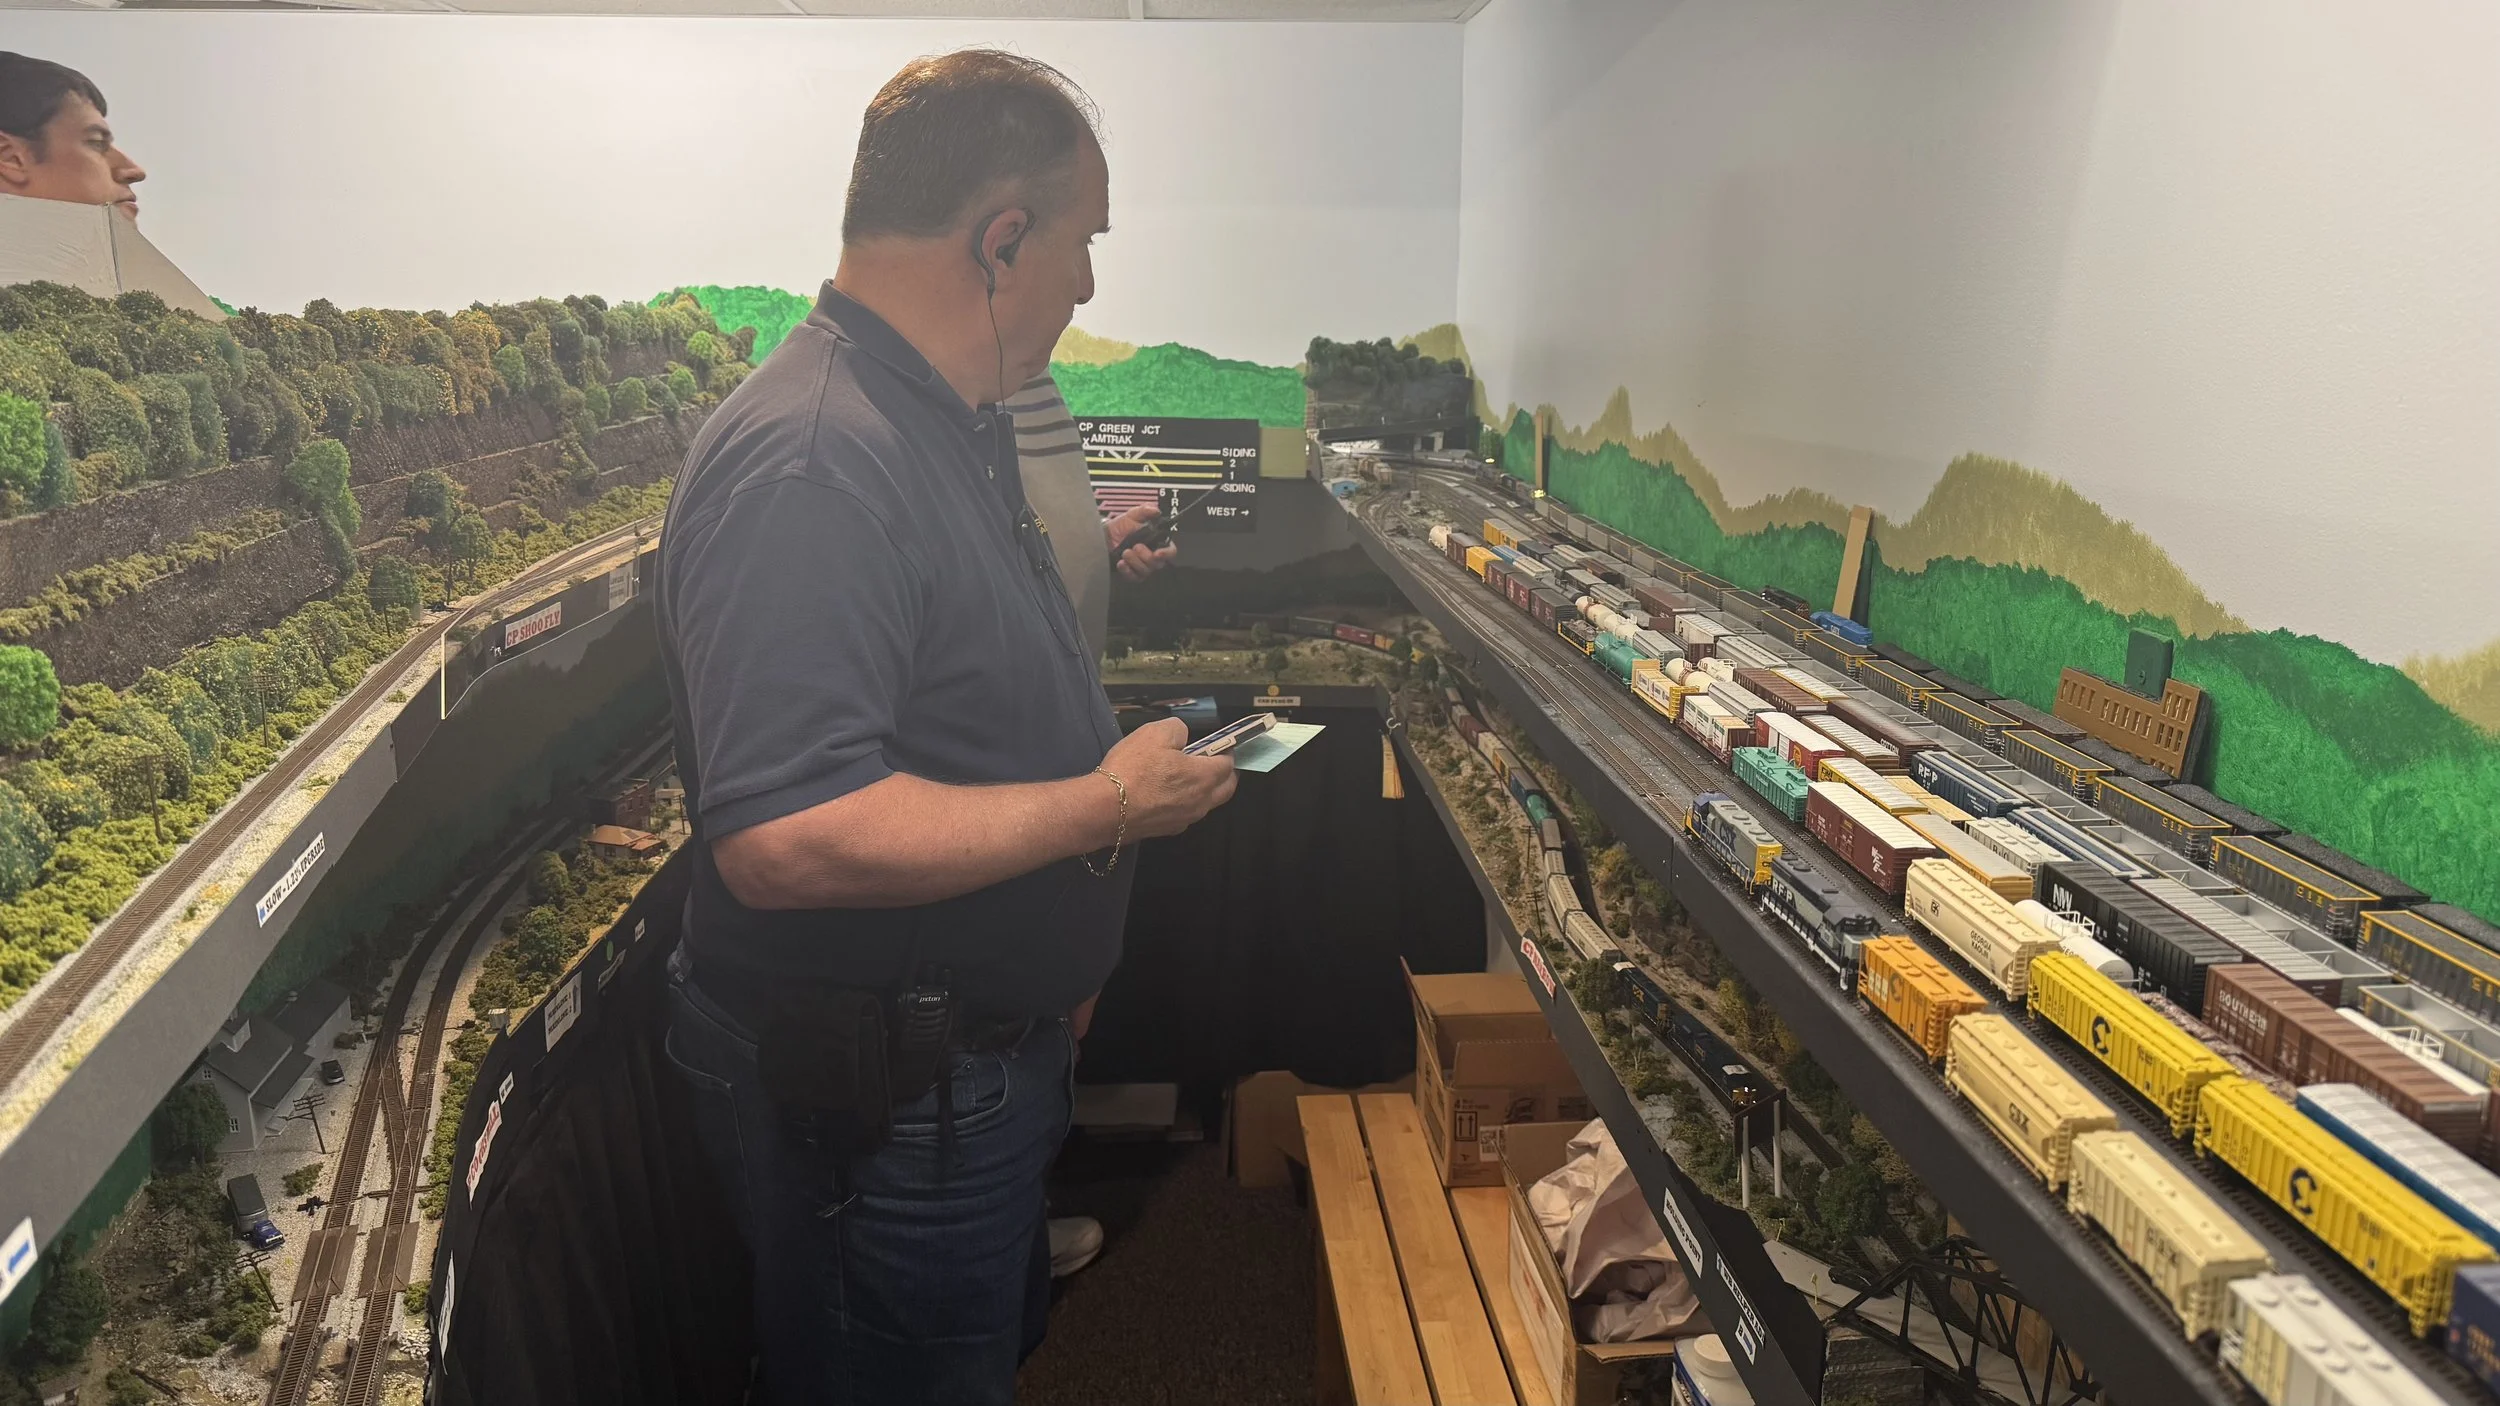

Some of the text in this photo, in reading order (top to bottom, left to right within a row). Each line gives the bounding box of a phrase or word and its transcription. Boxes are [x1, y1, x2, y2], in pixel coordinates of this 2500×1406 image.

[1078, 422, 1161, 435] CP GREEN JCT
[1090, 433, 1133, 445] AMTRAK
[1222, 448, 1257, 458] SIDING
[1229, 459, 1236, 468] 2
[1143, 465, 1150, 474] 6
[1229, 471, 1235, 480] 1
[1222, 483, 1256, 494] SIDING
[1207, 506, 1237, 517] WEST
[506, 610, 561, 647] CP SHOO FLY
[265, 885, 282, 913] SLOW
[2219, 989, 2268, 1032] SOUTHERN
[1684, 1232, 1702, 1264] POINT
